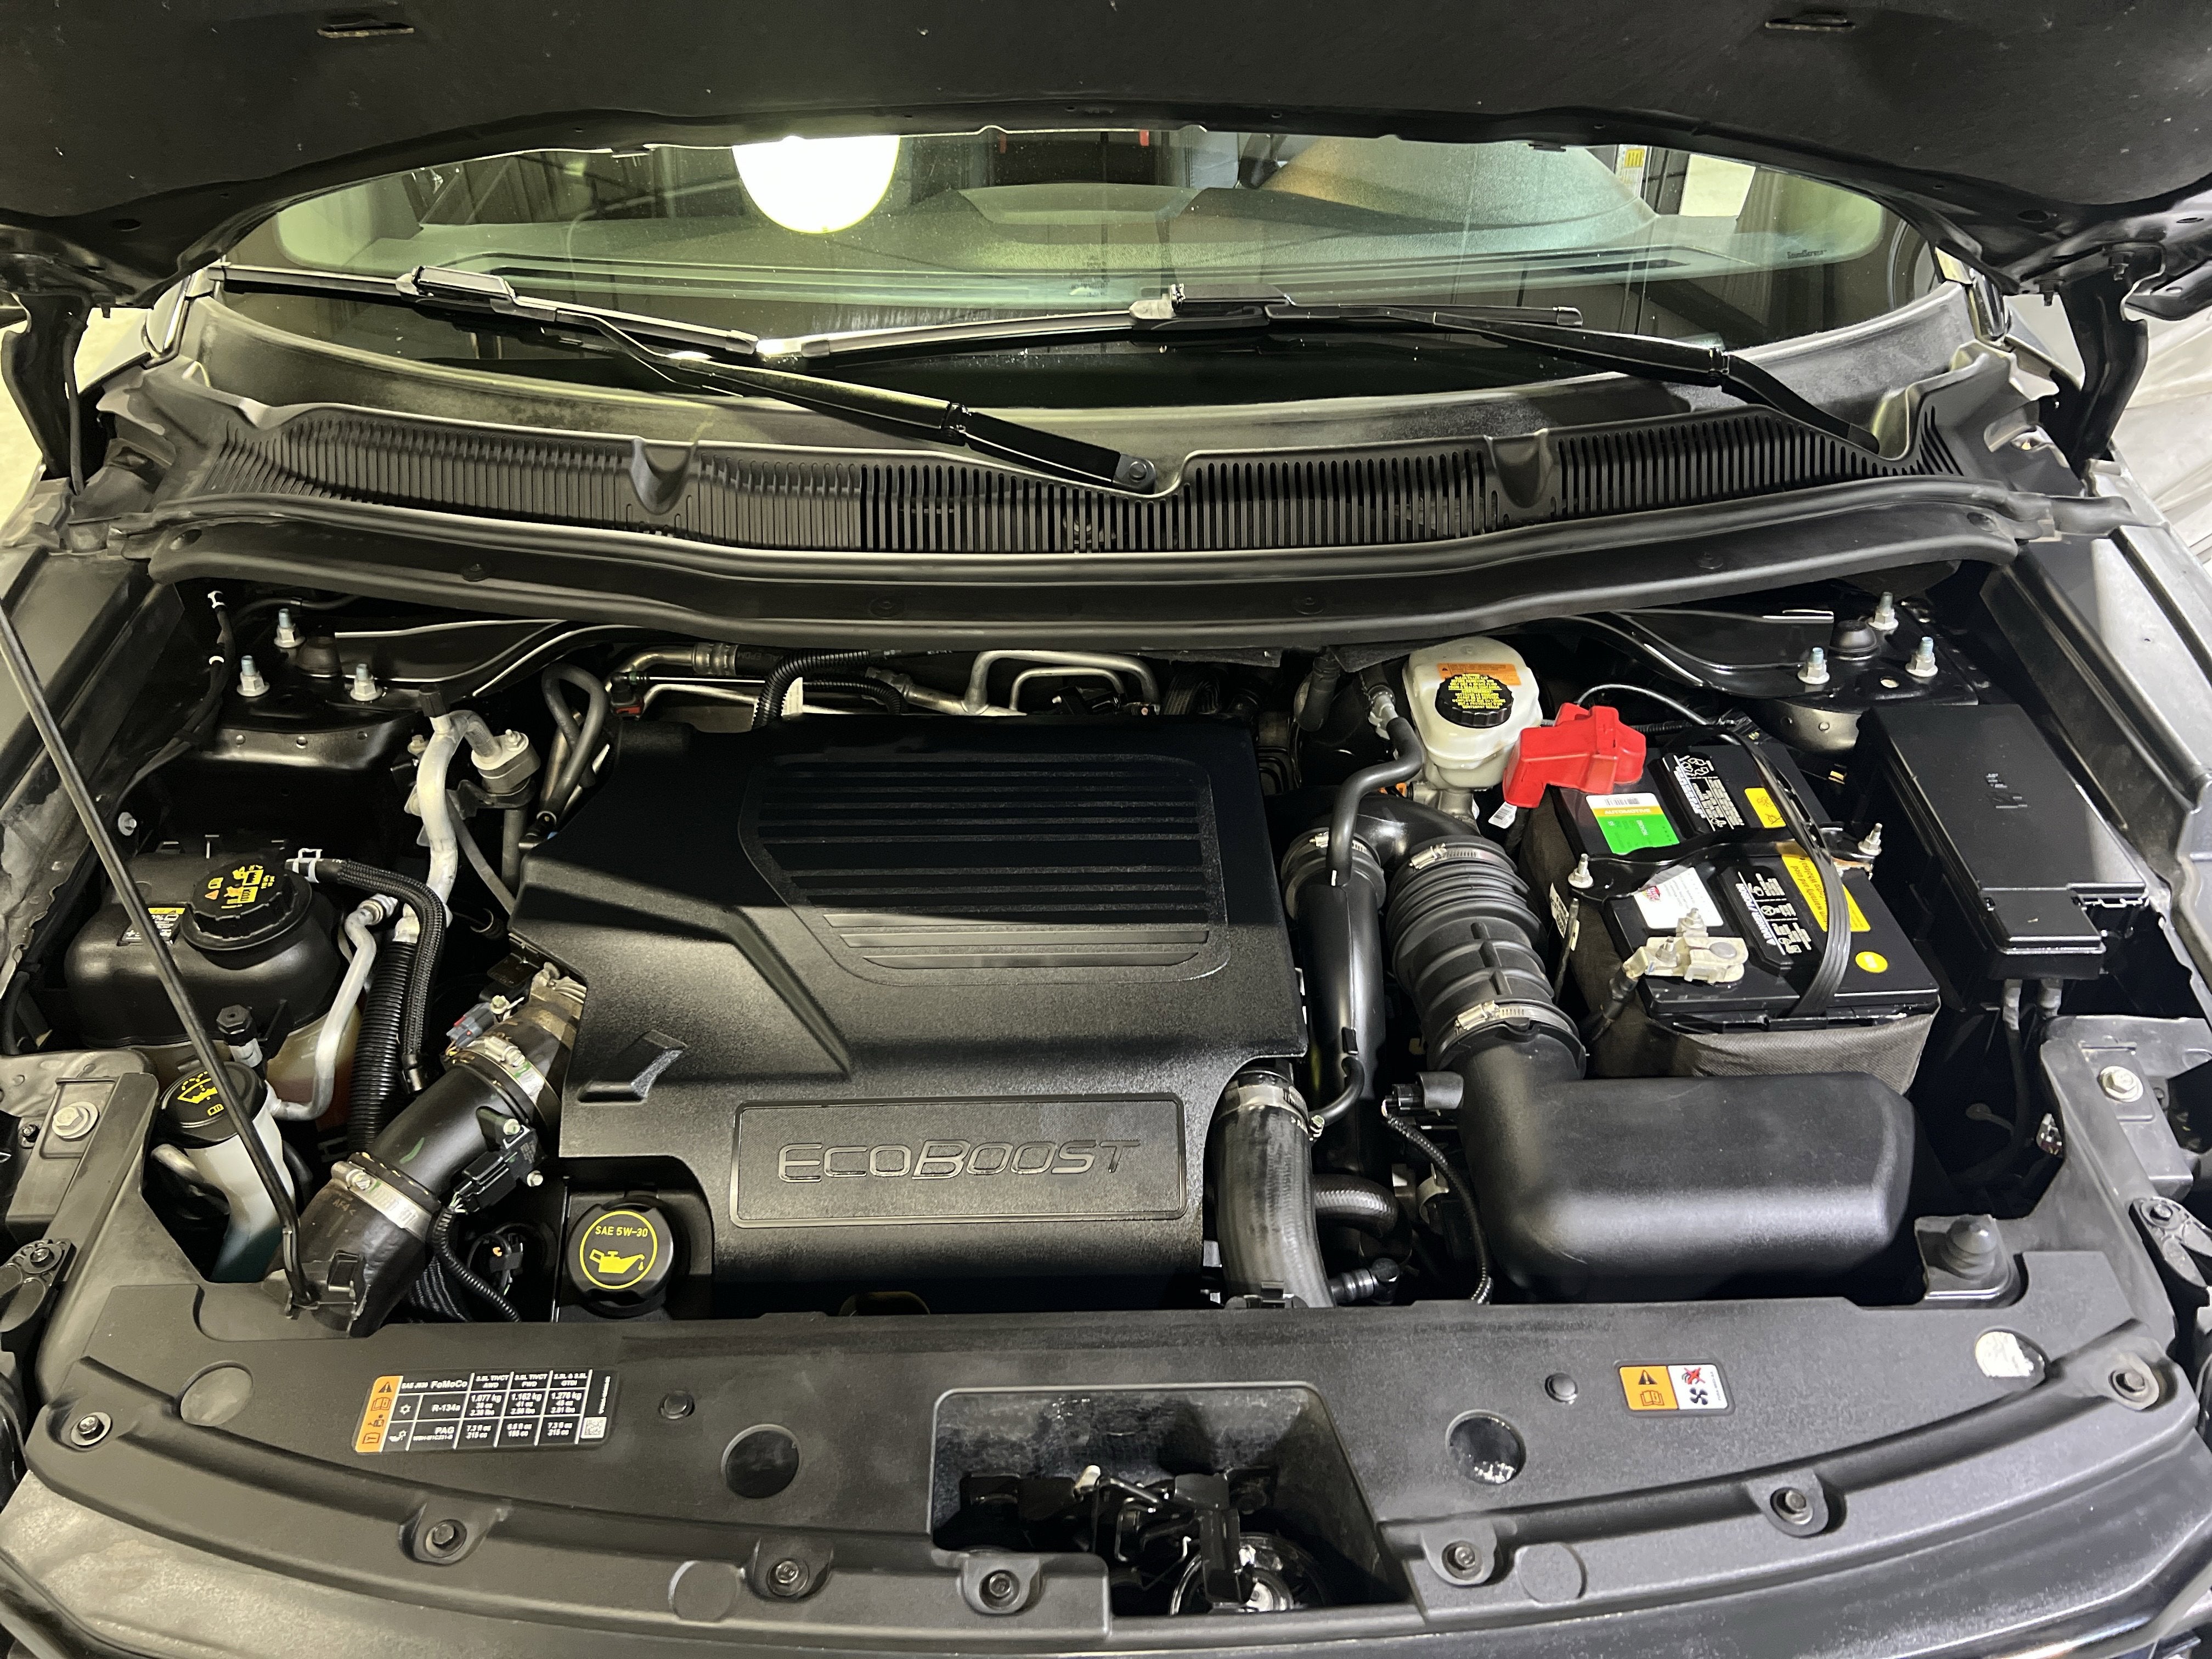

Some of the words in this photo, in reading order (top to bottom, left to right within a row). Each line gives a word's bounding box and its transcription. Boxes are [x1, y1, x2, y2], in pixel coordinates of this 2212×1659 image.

[1791, 865, 1804, 878] used
[1797, 878, 1809, 888] and
[1805, 888, 1822, 910] warranty
[595, 1226, 614, 1236] SAE
[616, 1226, 649, 1238] 5W-30
[431, 1380, 468, 1389] FoMoCo
[471, 1394, 491, 1402] 1.077
[492, 1394, 502, 1403] kg
[532, 1392, 543, 1402] kg
[572, 1392, 582, 1401] kg
[431, 1403, 461, 1412] R-134a
[435, 1426, 455, 1435] PAG
